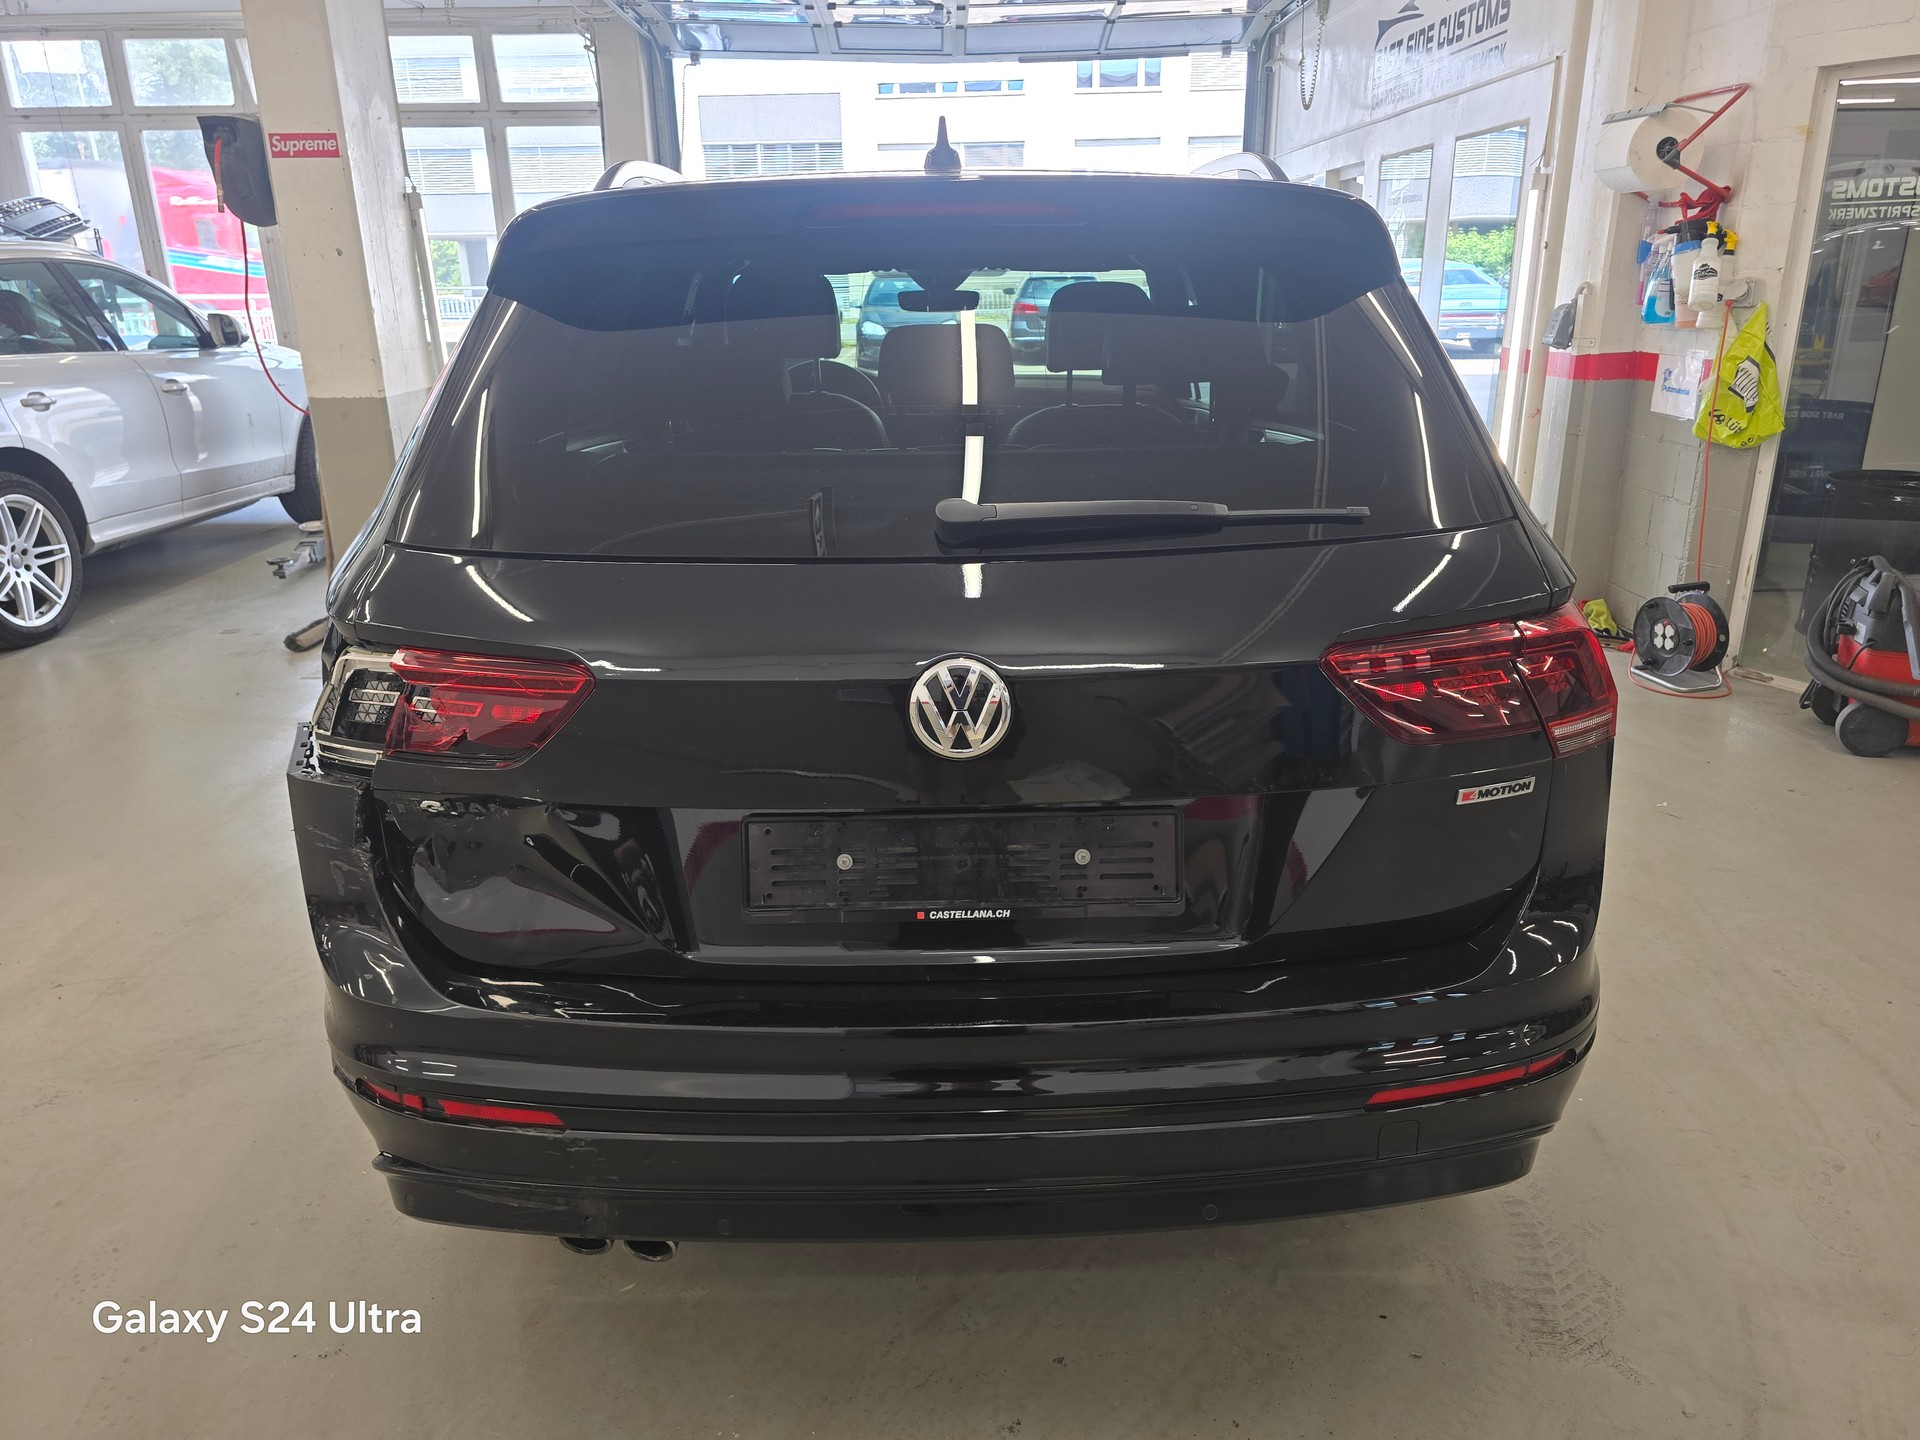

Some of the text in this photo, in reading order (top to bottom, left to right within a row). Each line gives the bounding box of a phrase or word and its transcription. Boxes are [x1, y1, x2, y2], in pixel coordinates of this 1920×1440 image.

[1436, 0, 1512, 51] CUSTOMS
[272, 136, 338, 157] Supreme
[929, 910, 1011, 920] CASTELLANA.CH
